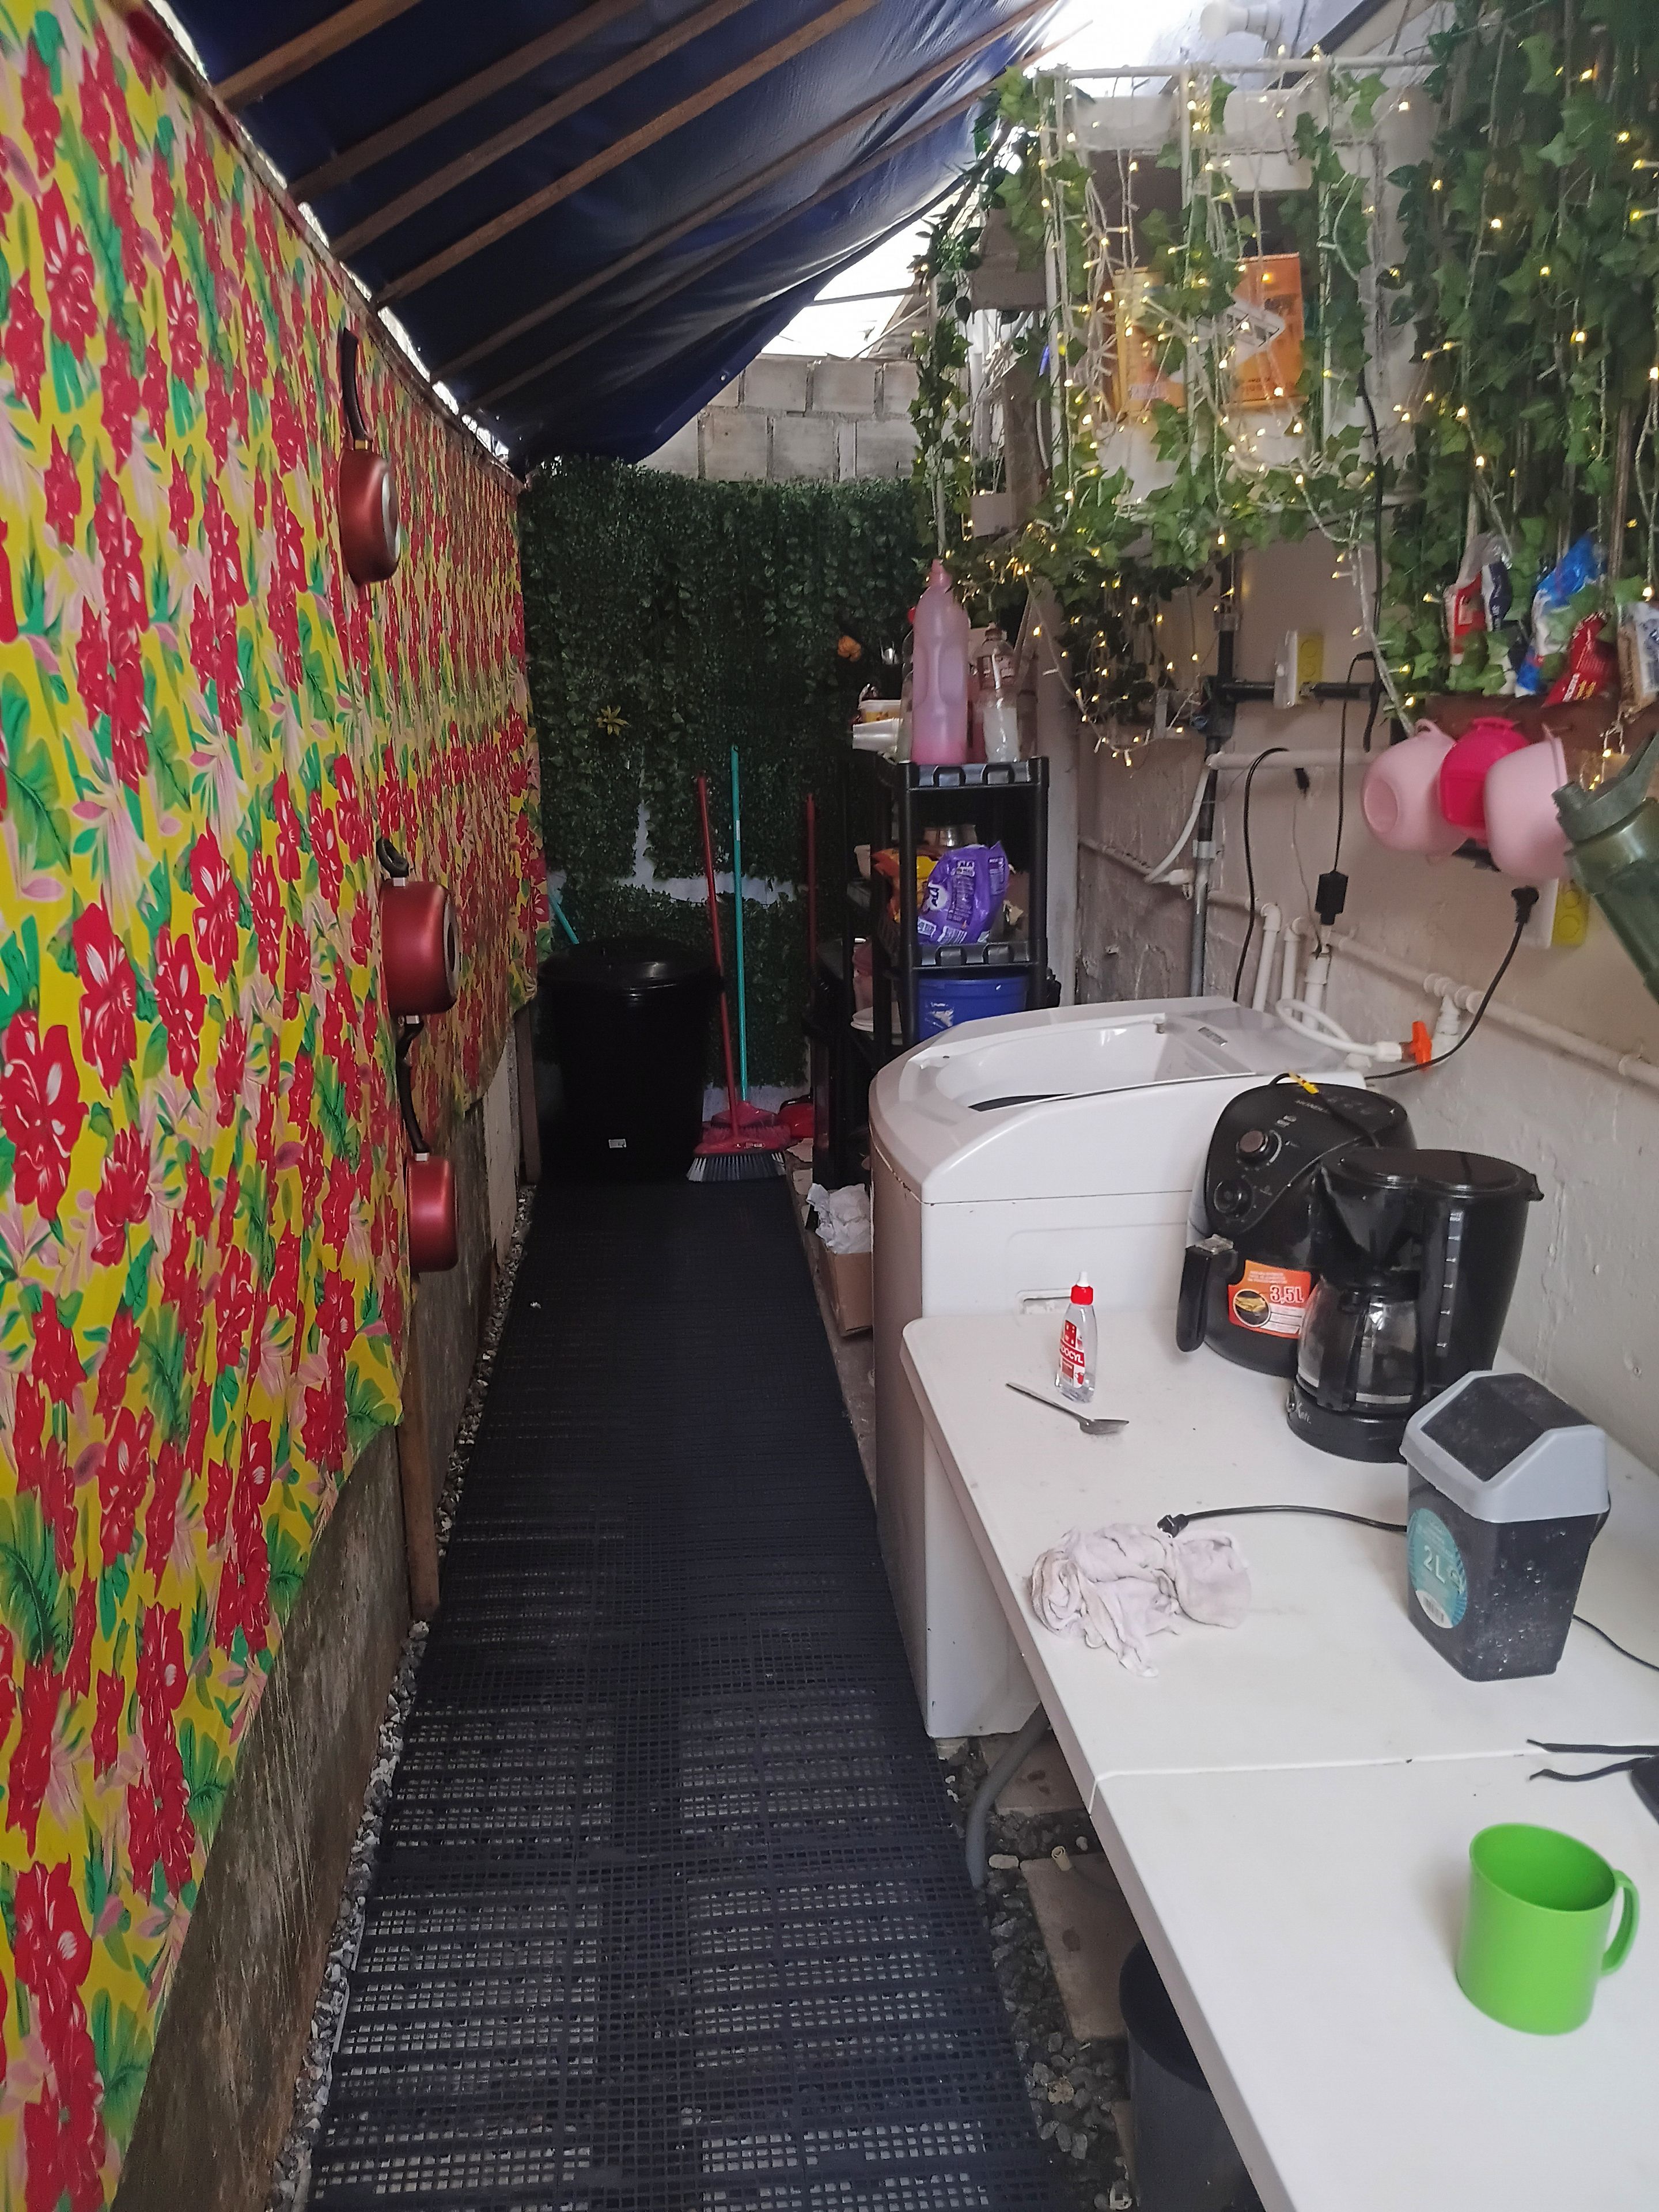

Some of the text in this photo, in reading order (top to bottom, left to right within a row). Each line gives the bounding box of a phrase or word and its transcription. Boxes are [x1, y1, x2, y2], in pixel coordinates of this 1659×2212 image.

[928, 885, 940, 907] ALA
[1269, 1285, 1304, 1304] 3,5L
[1060, 1344, 1084, 1364] DOCYL
[1423, 1544, 1445, 1584] 2L
